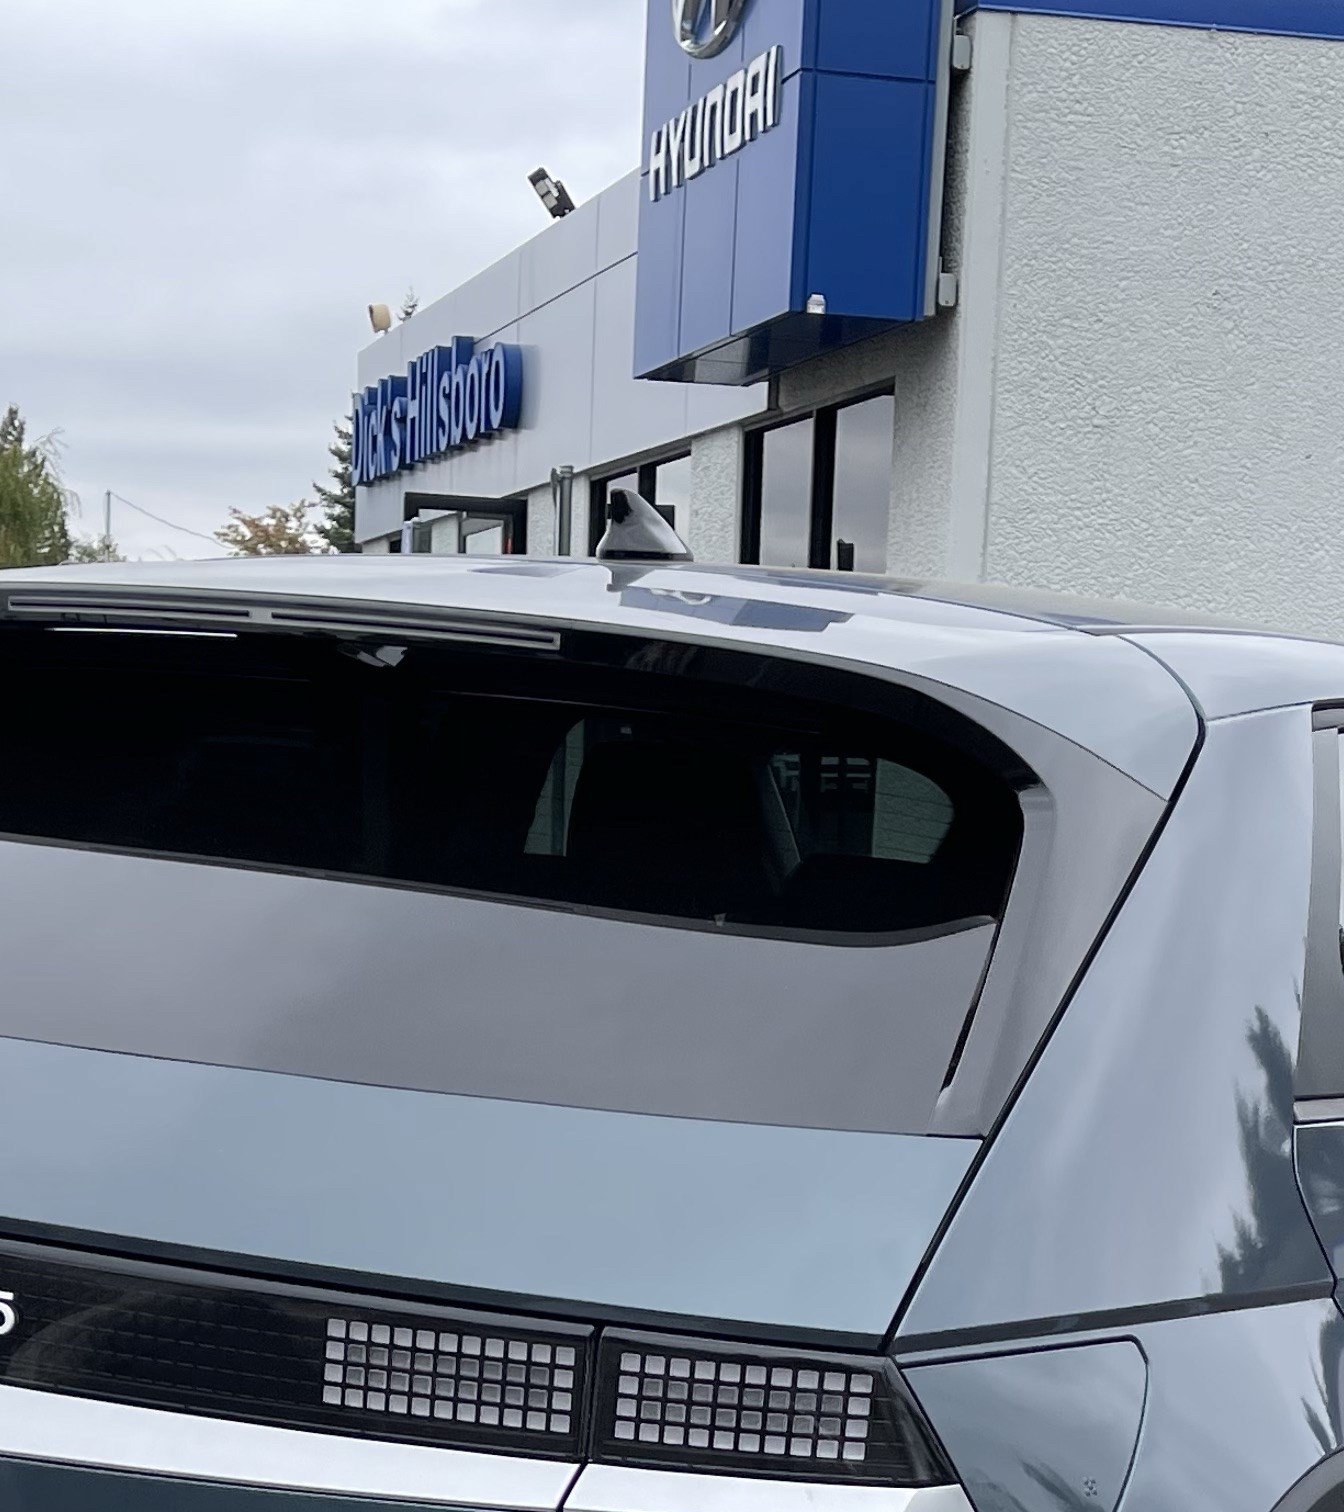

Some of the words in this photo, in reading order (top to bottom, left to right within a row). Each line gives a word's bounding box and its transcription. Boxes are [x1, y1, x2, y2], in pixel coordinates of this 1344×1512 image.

[649, 44, 782, 202] HYUNDAI
[351, 374, 406, 487] Dick's
[406, 335, 520, 464] Hillsboro
